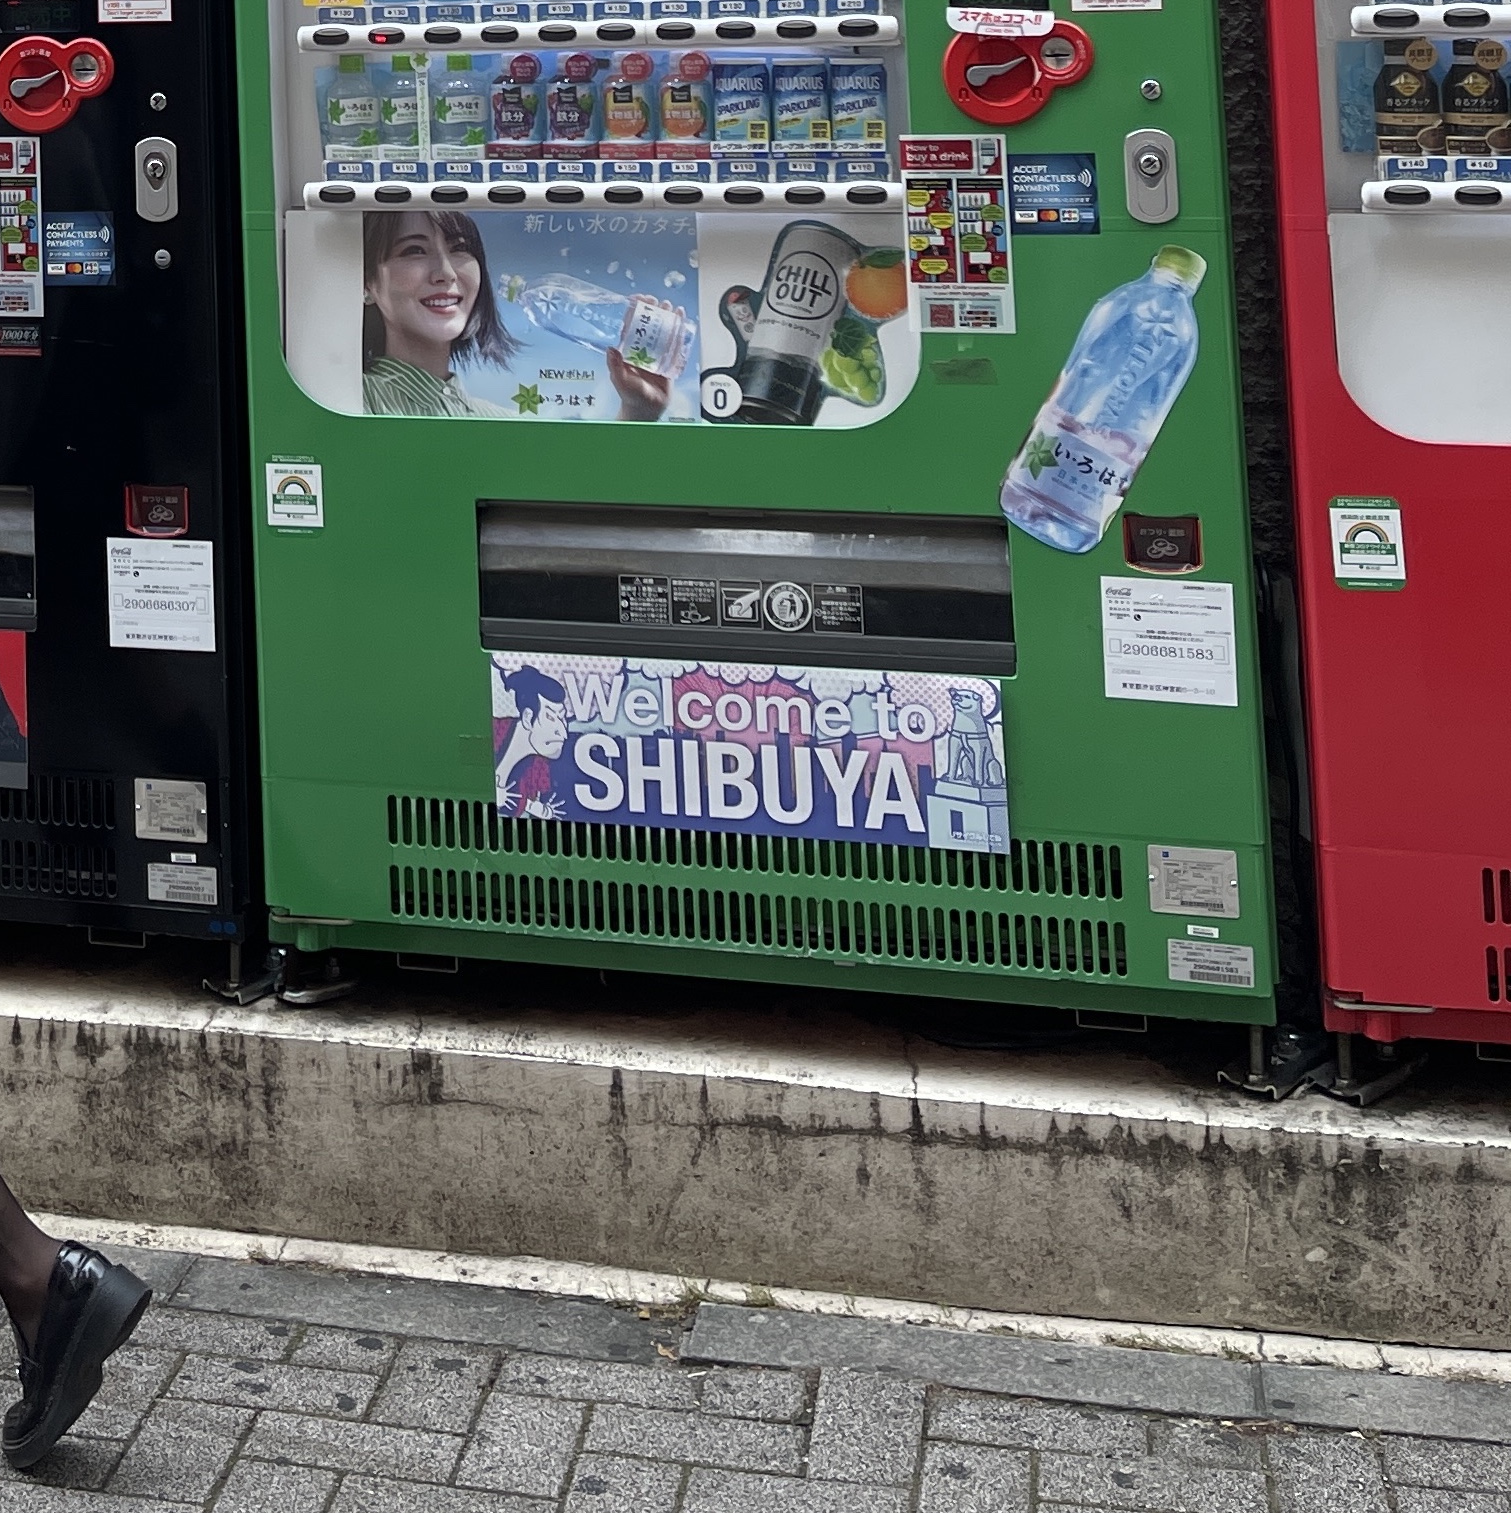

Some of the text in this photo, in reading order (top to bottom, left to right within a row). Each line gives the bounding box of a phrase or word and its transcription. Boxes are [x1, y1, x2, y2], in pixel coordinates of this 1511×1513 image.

[957, 11, 1042, 25] スマホはココへ!!
[717, 97, 761, 116] SPARKLING
[777, 96, 821, 116] SPARKLING
[1013, 165, 1048, 174] ACCEPT
[1013, 174, 1077, 183] CONTACTLESS
[1013, 183, 1060, 192] PAYMENTS
[46, 223, 74, 231] ACCEPT
[524, 214, 697, 235] 新しい水のカタチ。
[46, 231, 98, 239] CONTACTLESS
[46, 239, 84, 248] PAYMENTS
[776, 264, 831, 300] CHILL
[776, 282, 822, 311] OUT
[539, 369, 595, 380] NEW ボトル!
[713, 389, 728, 410] 0
[1122, 644, 1214, 661] 2906681583
[564, 672, 935, 744] Welcome to
[574, 734, 926, 833] SHIBUYA
